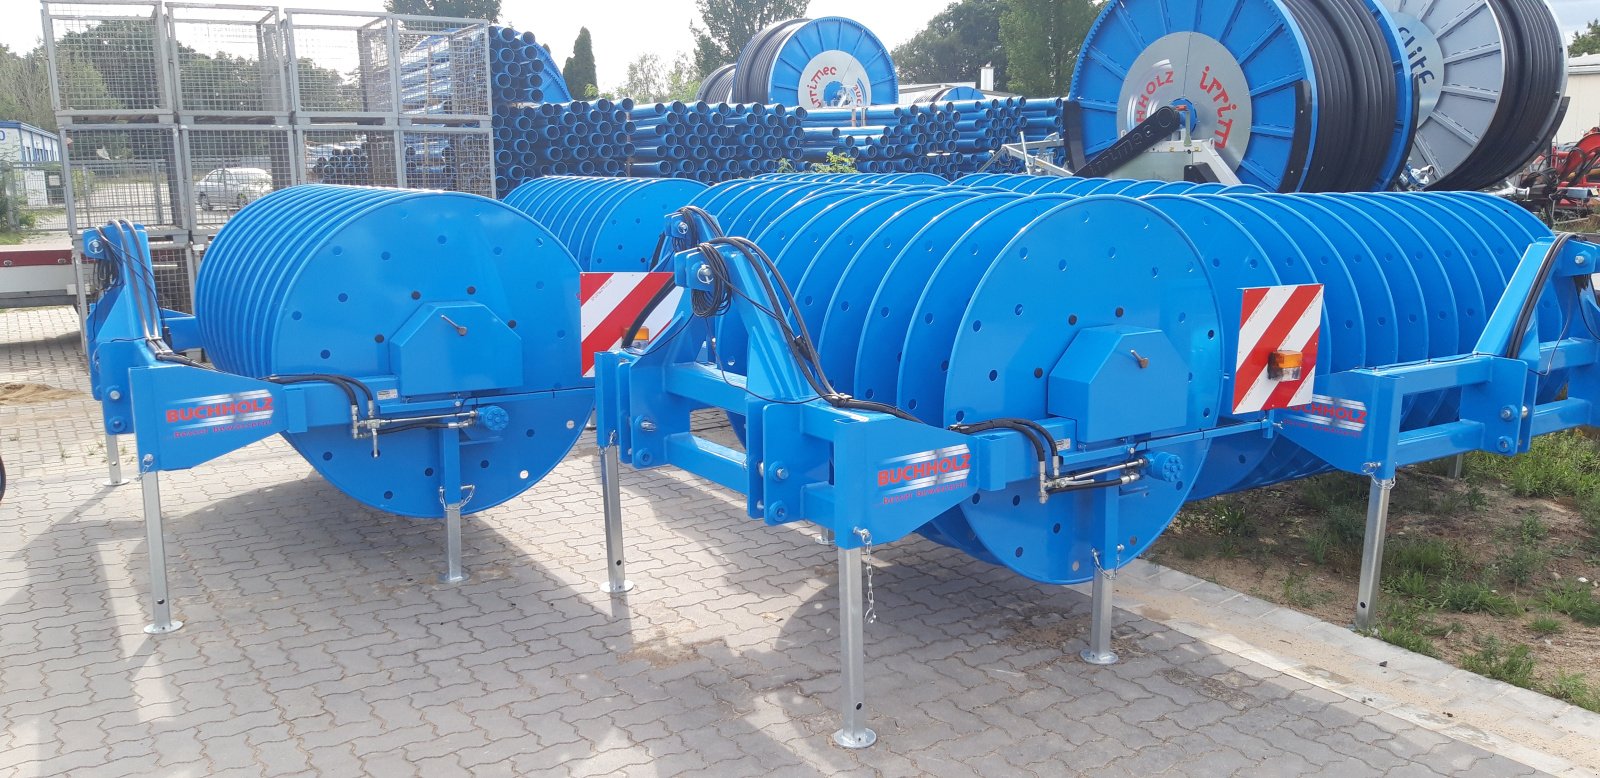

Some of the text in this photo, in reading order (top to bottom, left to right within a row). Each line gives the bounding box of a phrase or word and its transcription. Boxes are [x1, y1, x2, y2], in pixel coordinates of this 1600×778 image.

[1136, 71, 1174, 123] HHOLZ
[1199, 66, 1237, 149] irrim
[166, 397, 273, 422] BUCHHOLZ
[1290, 403, 1367, 424] CHHOLZ
[877, 454, 971, 486] BUCHHOLZ
